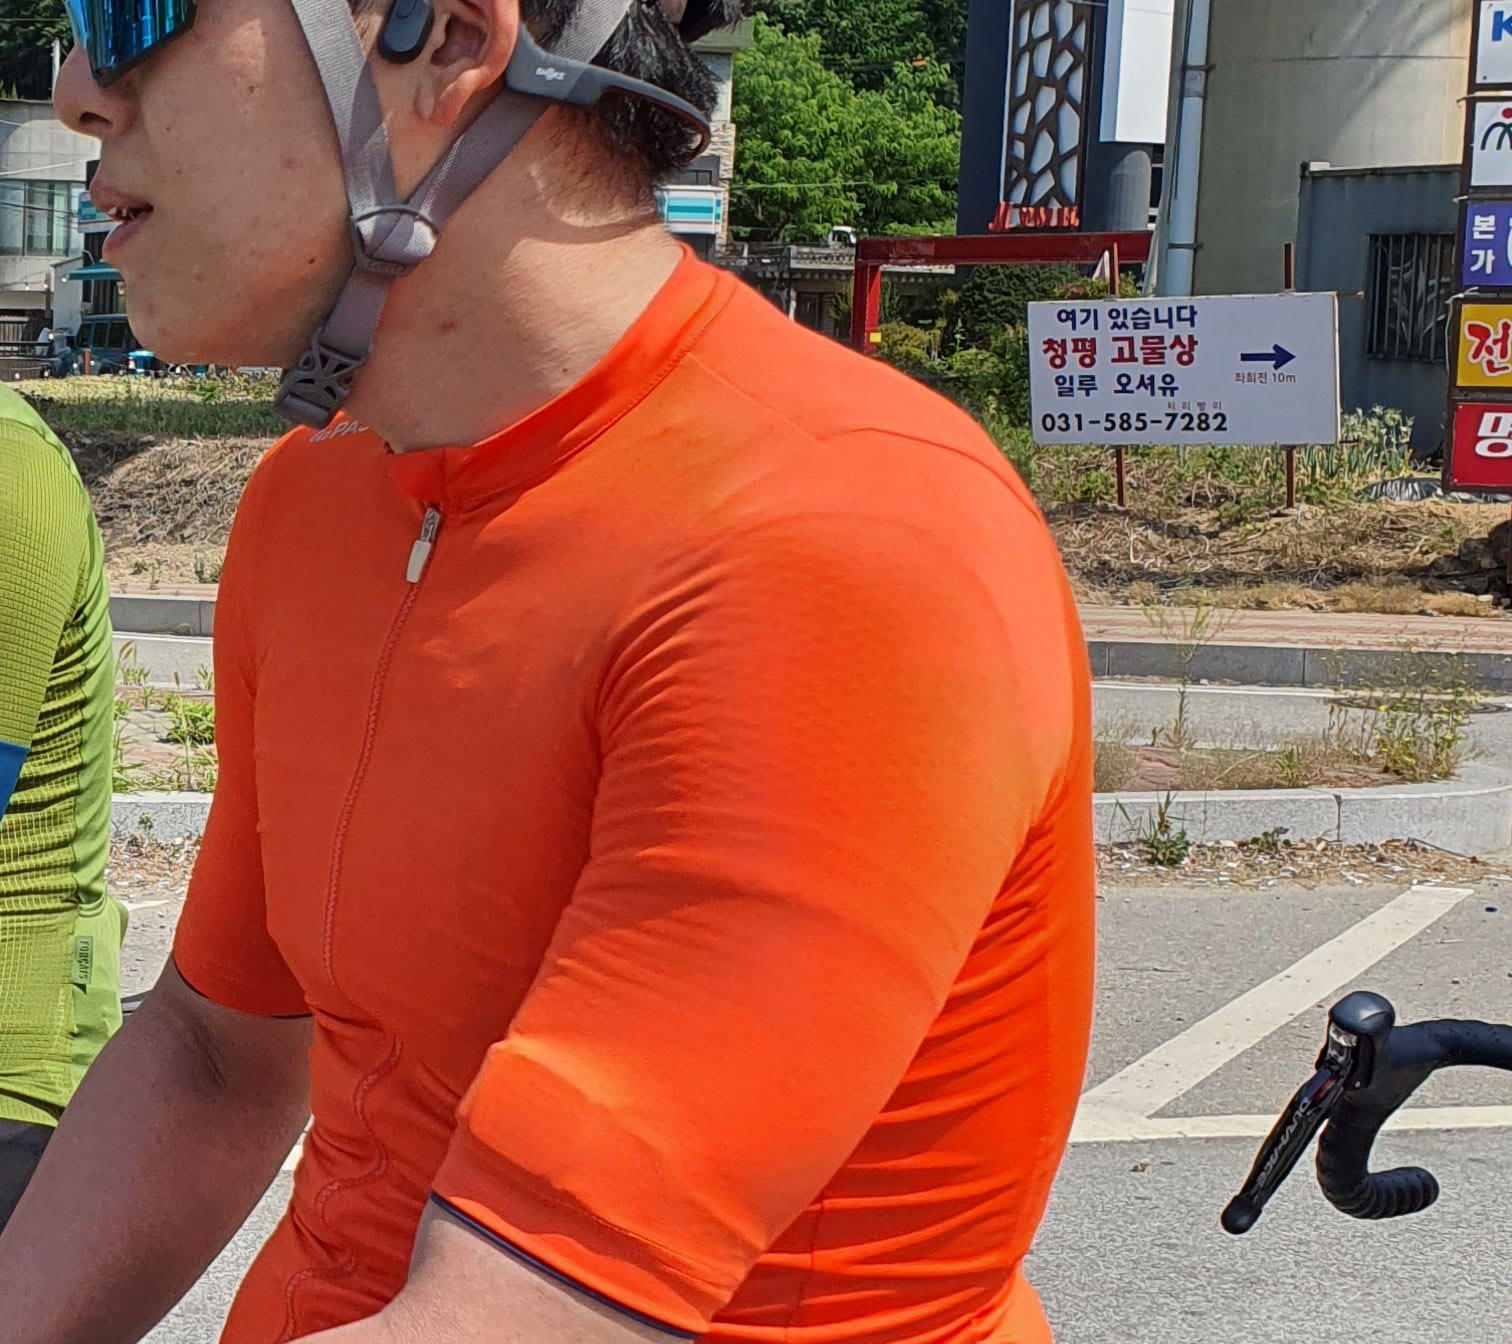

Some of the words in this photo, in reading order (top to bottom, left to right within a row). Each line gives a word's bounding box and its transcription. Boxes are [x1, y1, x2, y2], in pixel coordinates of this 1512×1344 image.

[1056, 307, 1099, 331] 여기
[1106, 304, 1198, 330] 있습니다
[1041, 336, 1098, 370] 청평
[1110, 334, 1199, 367] 고물상
[1054, 373, 1099, 398] 일루
[1112, 372, 1180, 398] 오셔유
[1271, 371, 1297, 384] 10m
[1040, 412, 1229, 433] 031-585-7282
